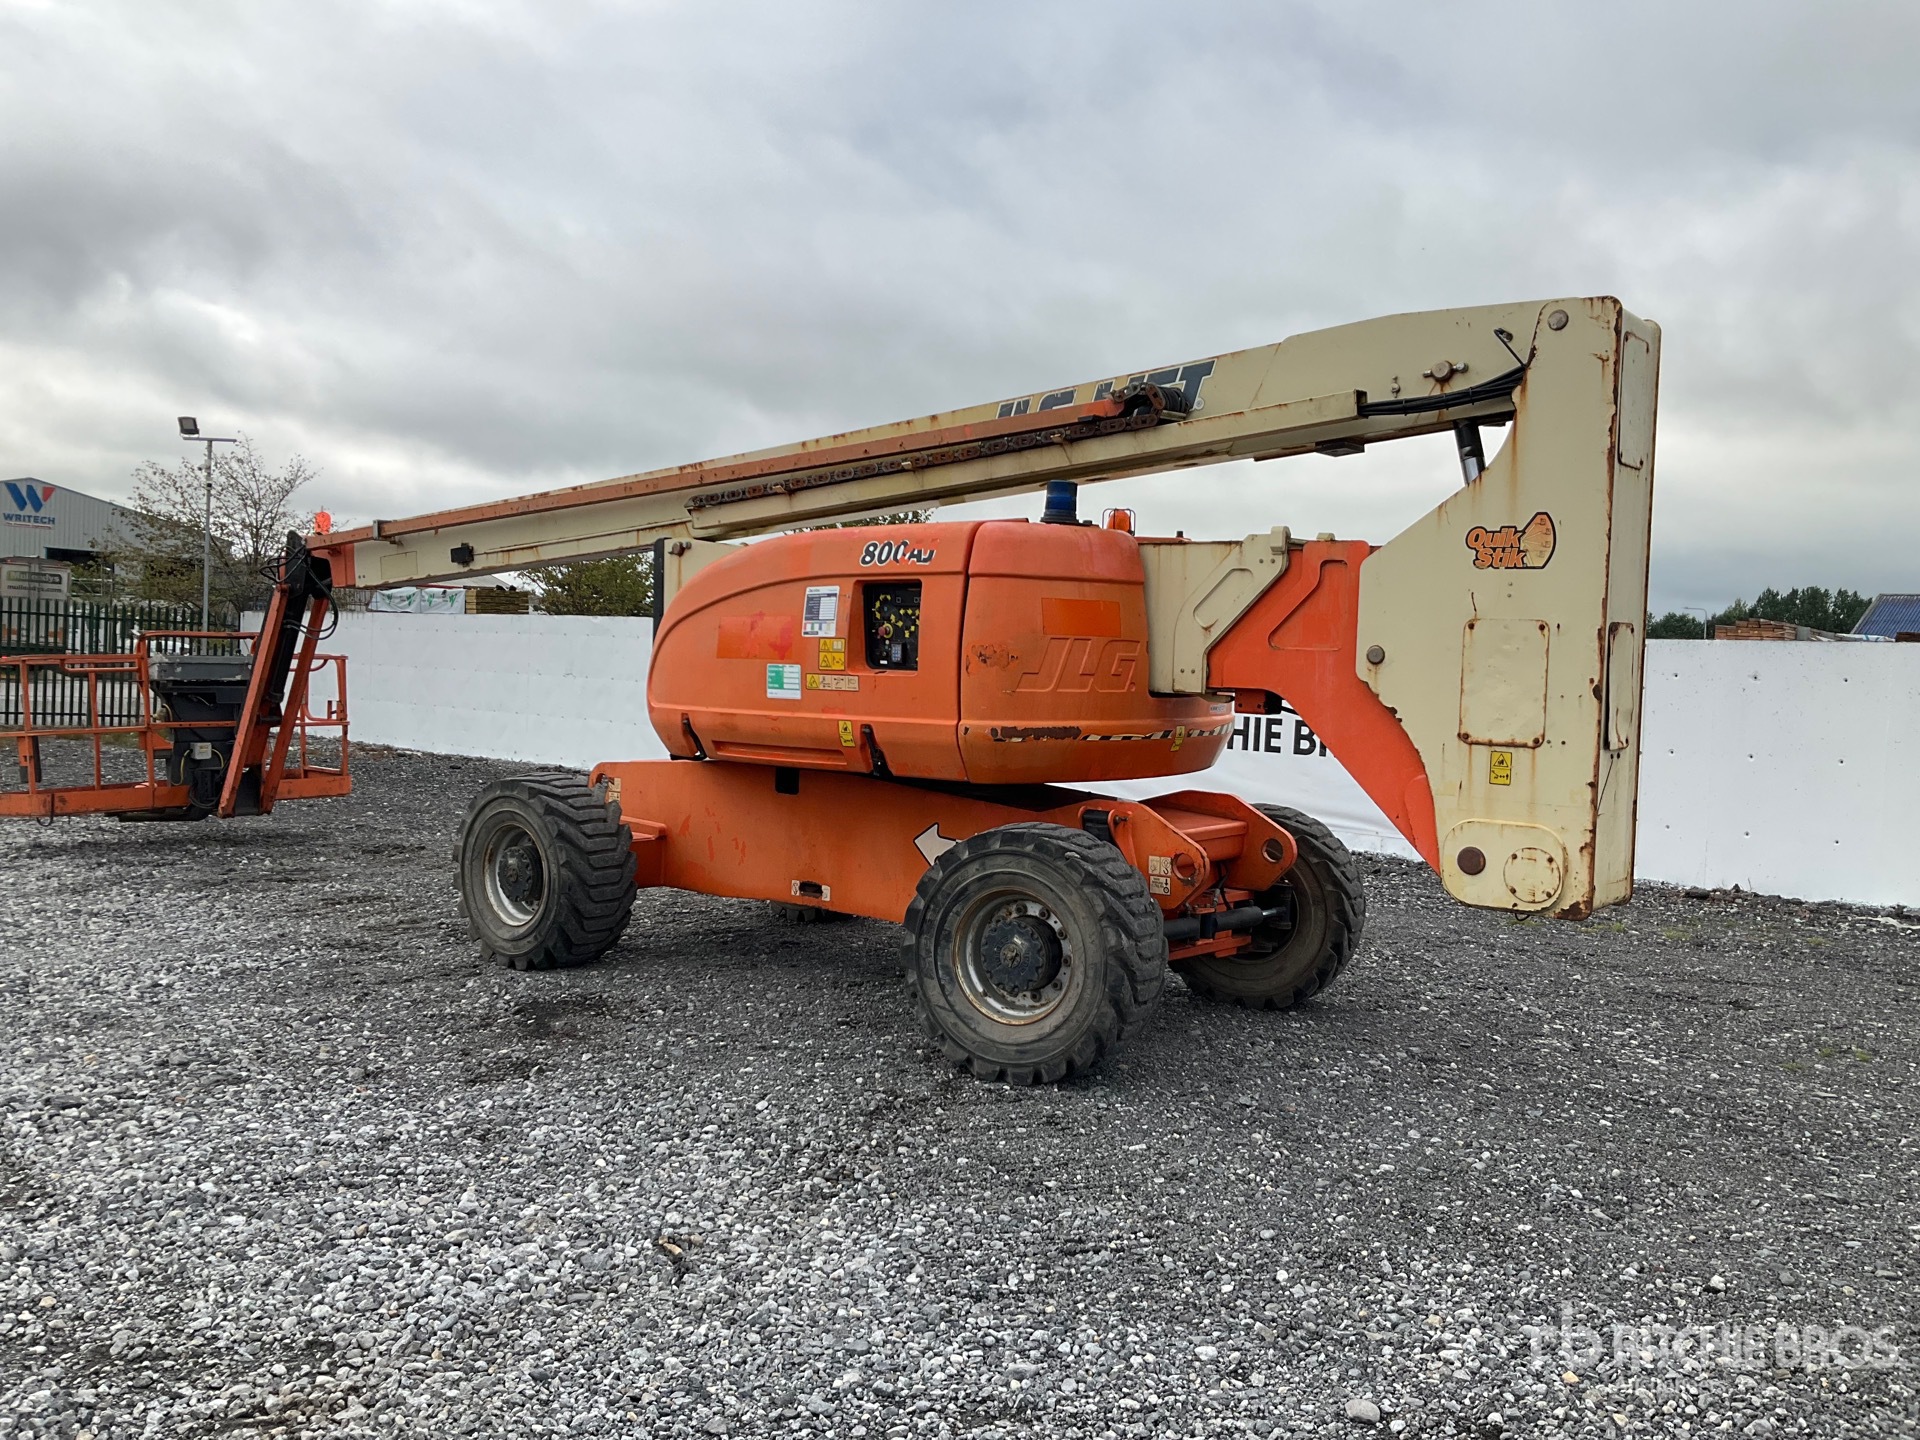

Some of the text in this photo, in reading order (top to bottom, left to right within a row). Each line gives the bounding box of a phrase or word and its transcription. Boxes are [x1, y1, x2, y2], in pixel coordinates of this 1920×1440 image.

[3, 512, 56, 525] WRITECH
[1466, 526, 1522, 551] Quik
[1473, 547, 1526, 569] Stik
[1015, 637, 1140, 693] JLG
[1293, 719, 1328, 757] B
